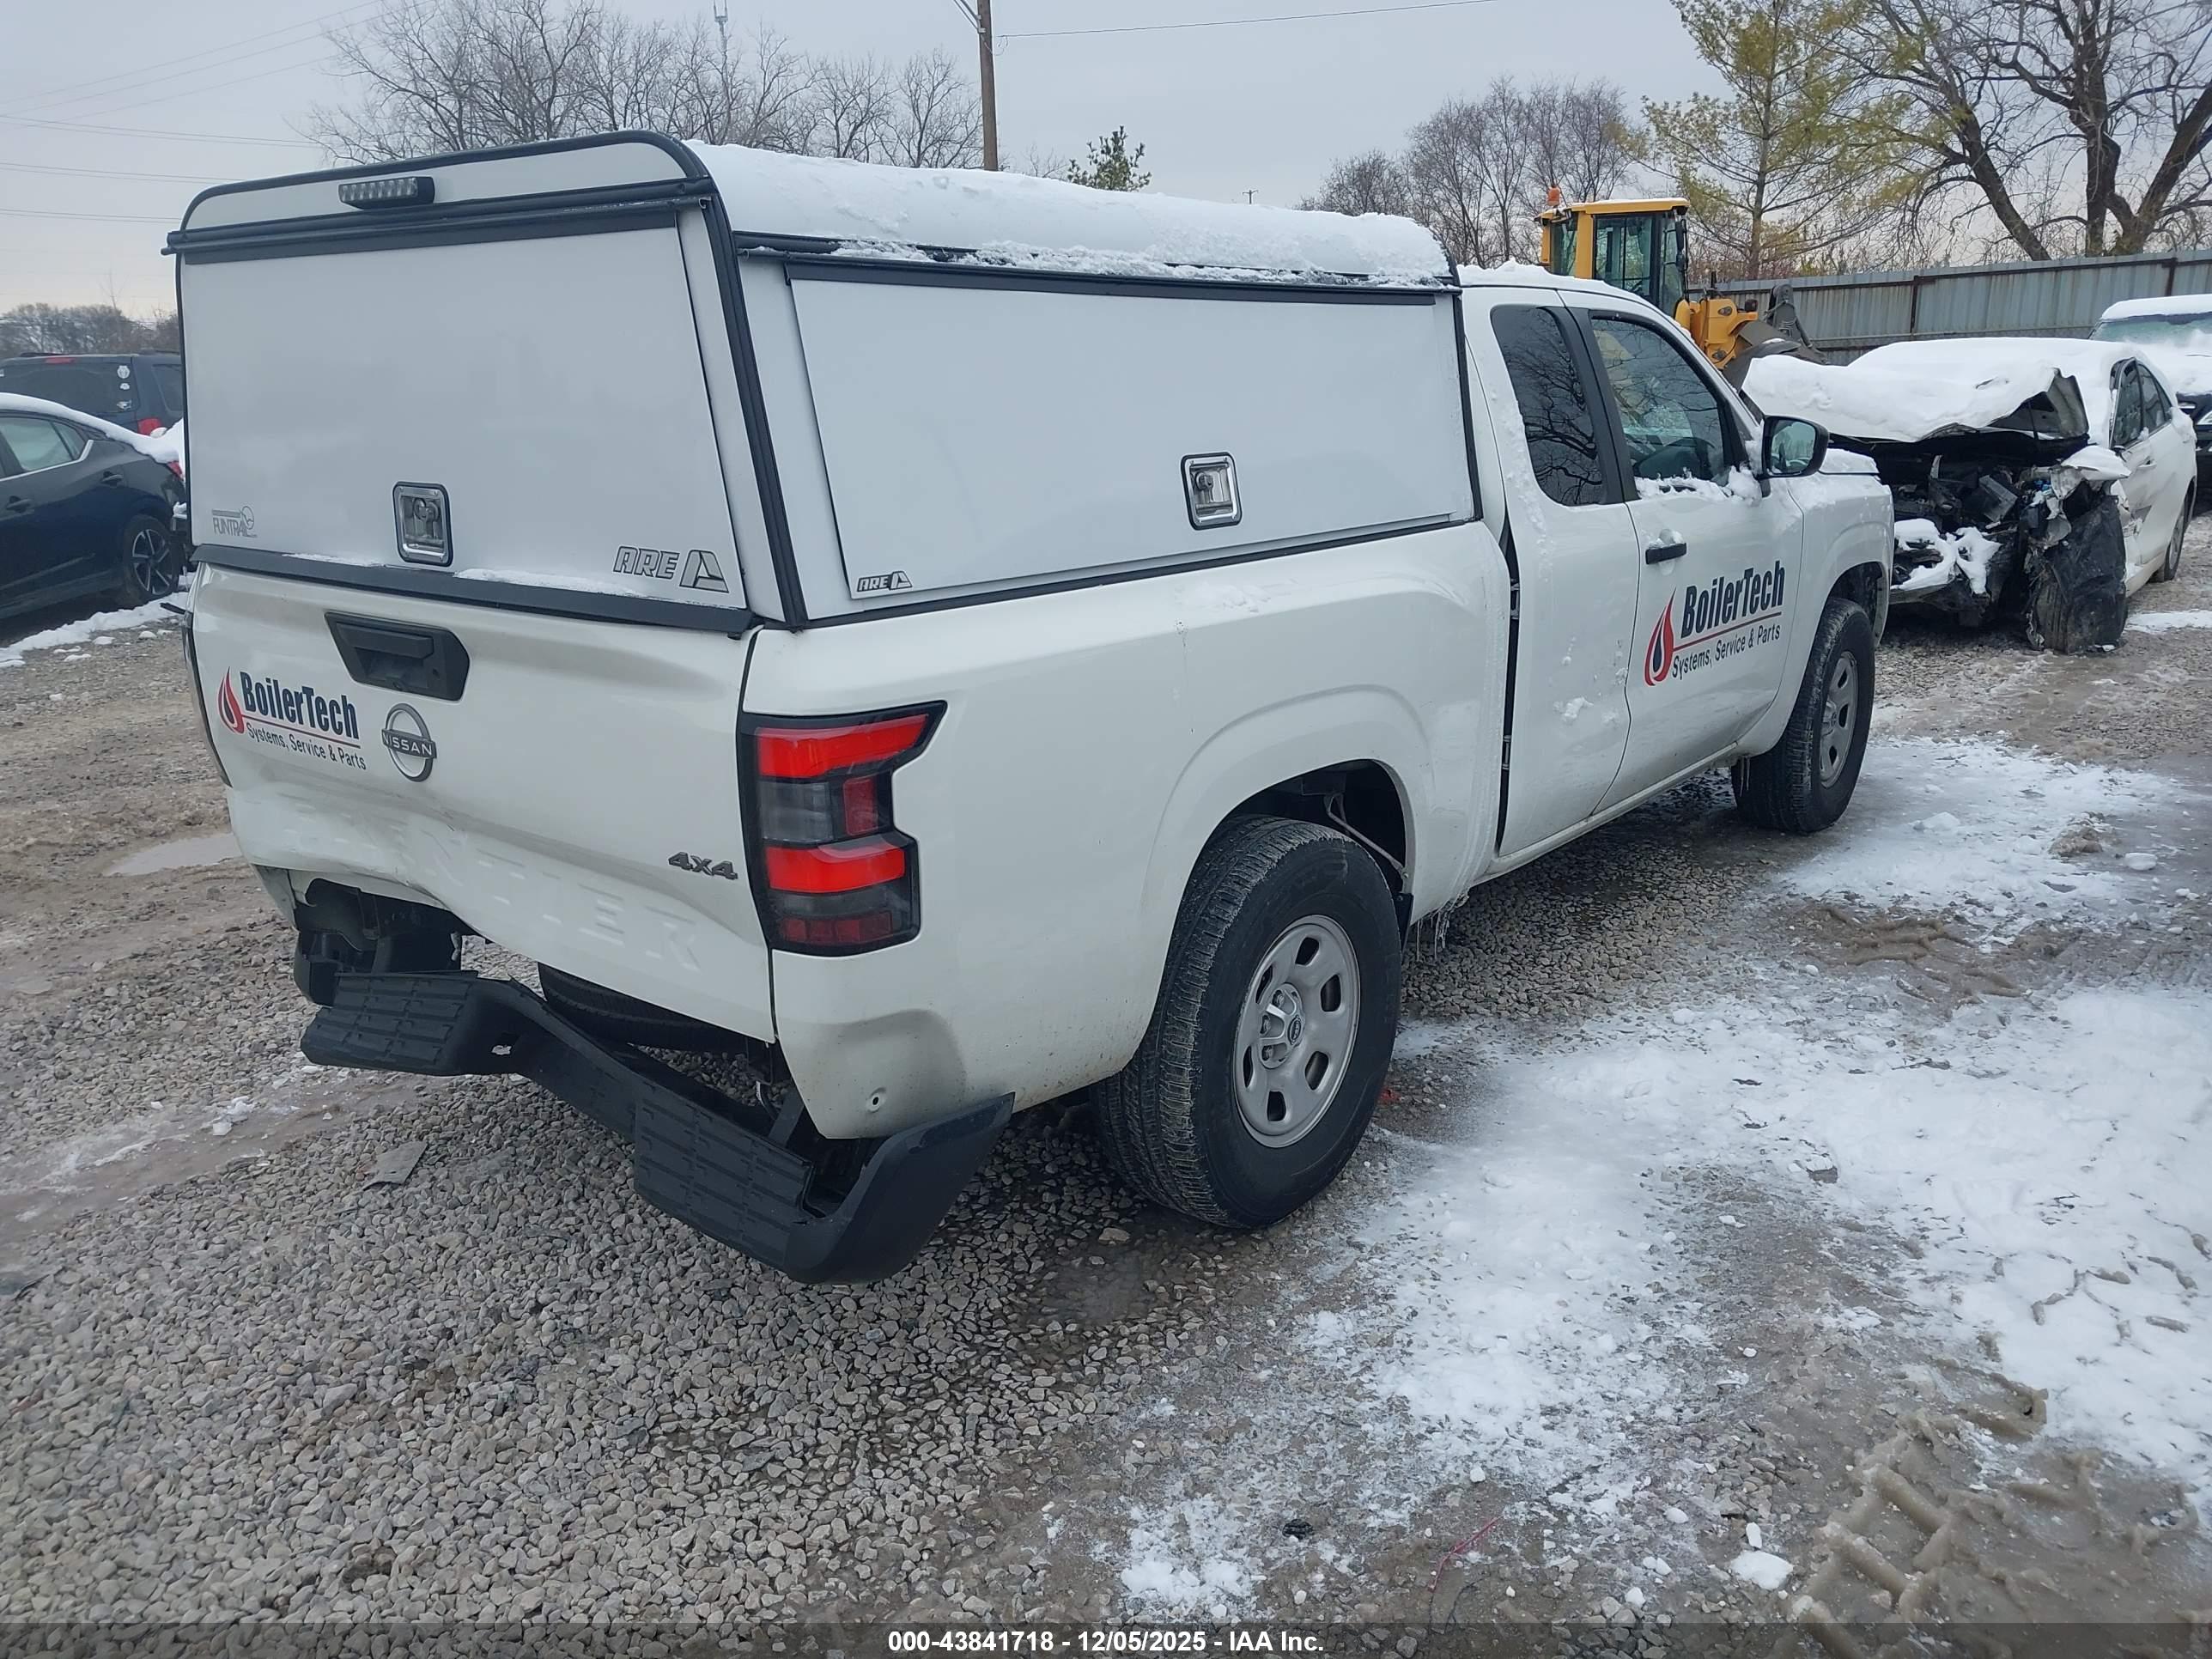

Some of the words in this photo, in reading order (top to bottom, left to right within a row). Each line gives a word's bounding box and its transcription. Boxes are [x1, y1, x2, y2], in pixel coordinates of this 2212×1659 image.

[1680, 561, 1785, 639] BoilerTech
[1672, 649, 1712, 680] Systems,
[1715, 635, 1746, 661] Service
[1748, 628, 1754, 648] &
[1758, 623, 1780, 645] Parts
[240, 671, 360, 740] BoilerTech
[246, 721, 289, 750] Systems,
[289, 733, 326, 759] Service
[329, 747, 337, 762] &
[337, 747, 367, 770] Parts
[383, 730, 433, 756] NISSAN
